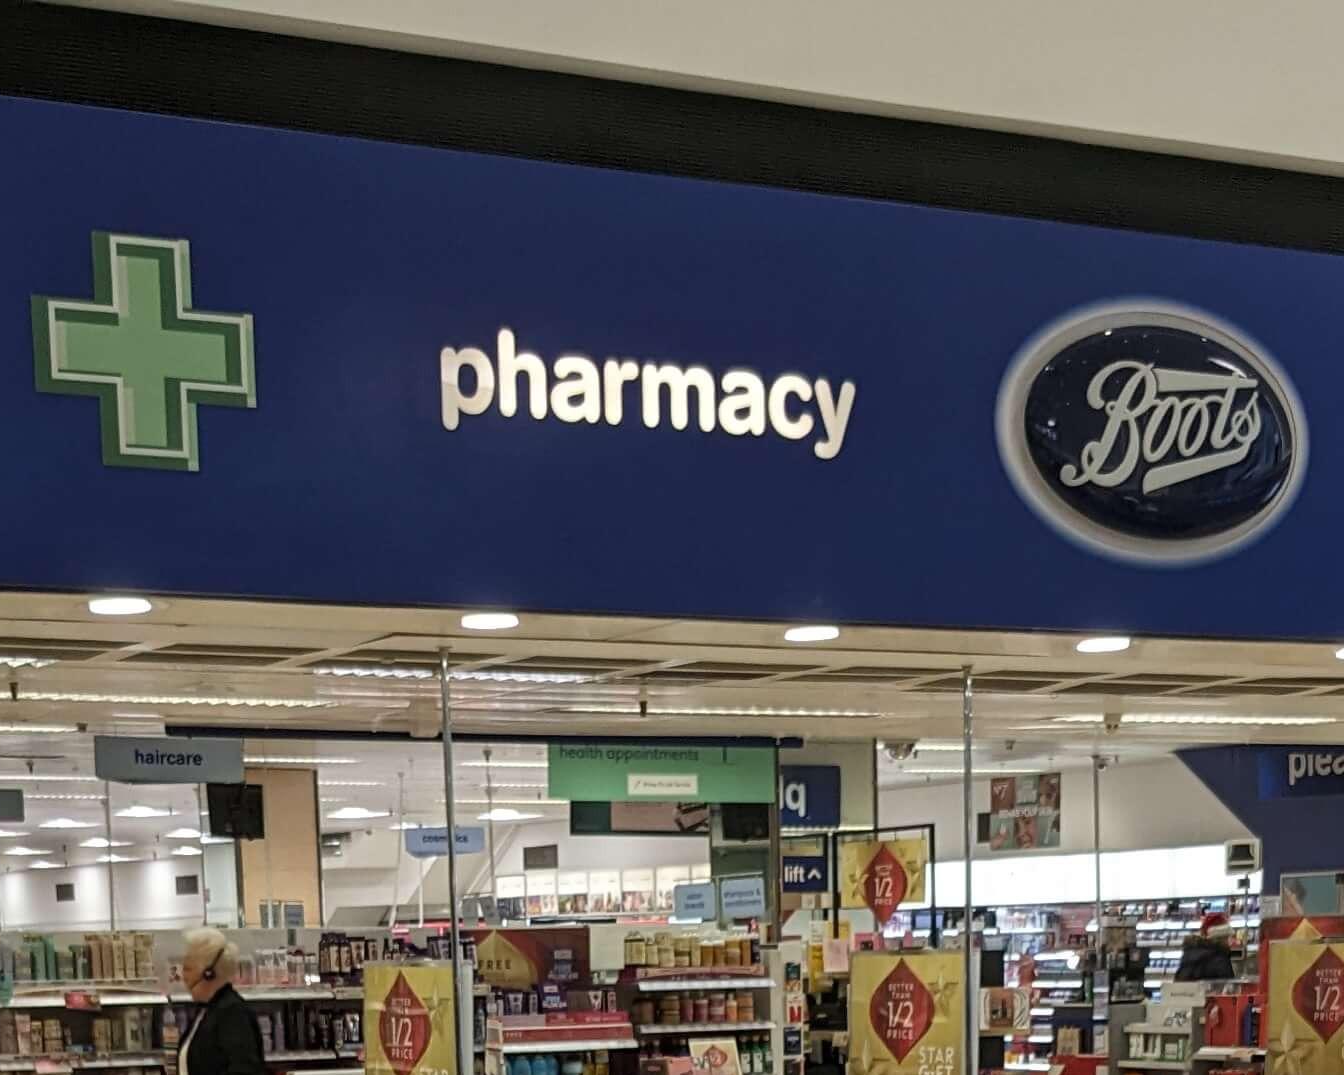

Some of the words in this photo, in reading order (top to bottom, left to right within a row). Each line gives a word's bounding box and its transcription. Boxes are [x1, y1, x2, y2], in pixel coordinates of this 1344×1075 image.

[440, 327, 856, 460] pharmacy
[1060, 360, 1261, 495] Boots
[134, 748, 204, 766] haircare
[559, 745, 603, 760] health
[607, 747, 699, 764] appointments
[784, 865, 806, 884] lift
[478, 959, 512, 970] FREE
[1314, 985, 1341, 1011] 1/2
[887, 1001, 914, 1028] 1/2
[1313, 1011, 1339, 1022] PRICE
[391, 1017, 413, 1047] 1/2
[886, 1029, 914, 1040] PRICE
[919, 1046, 955, 1064] STAR
